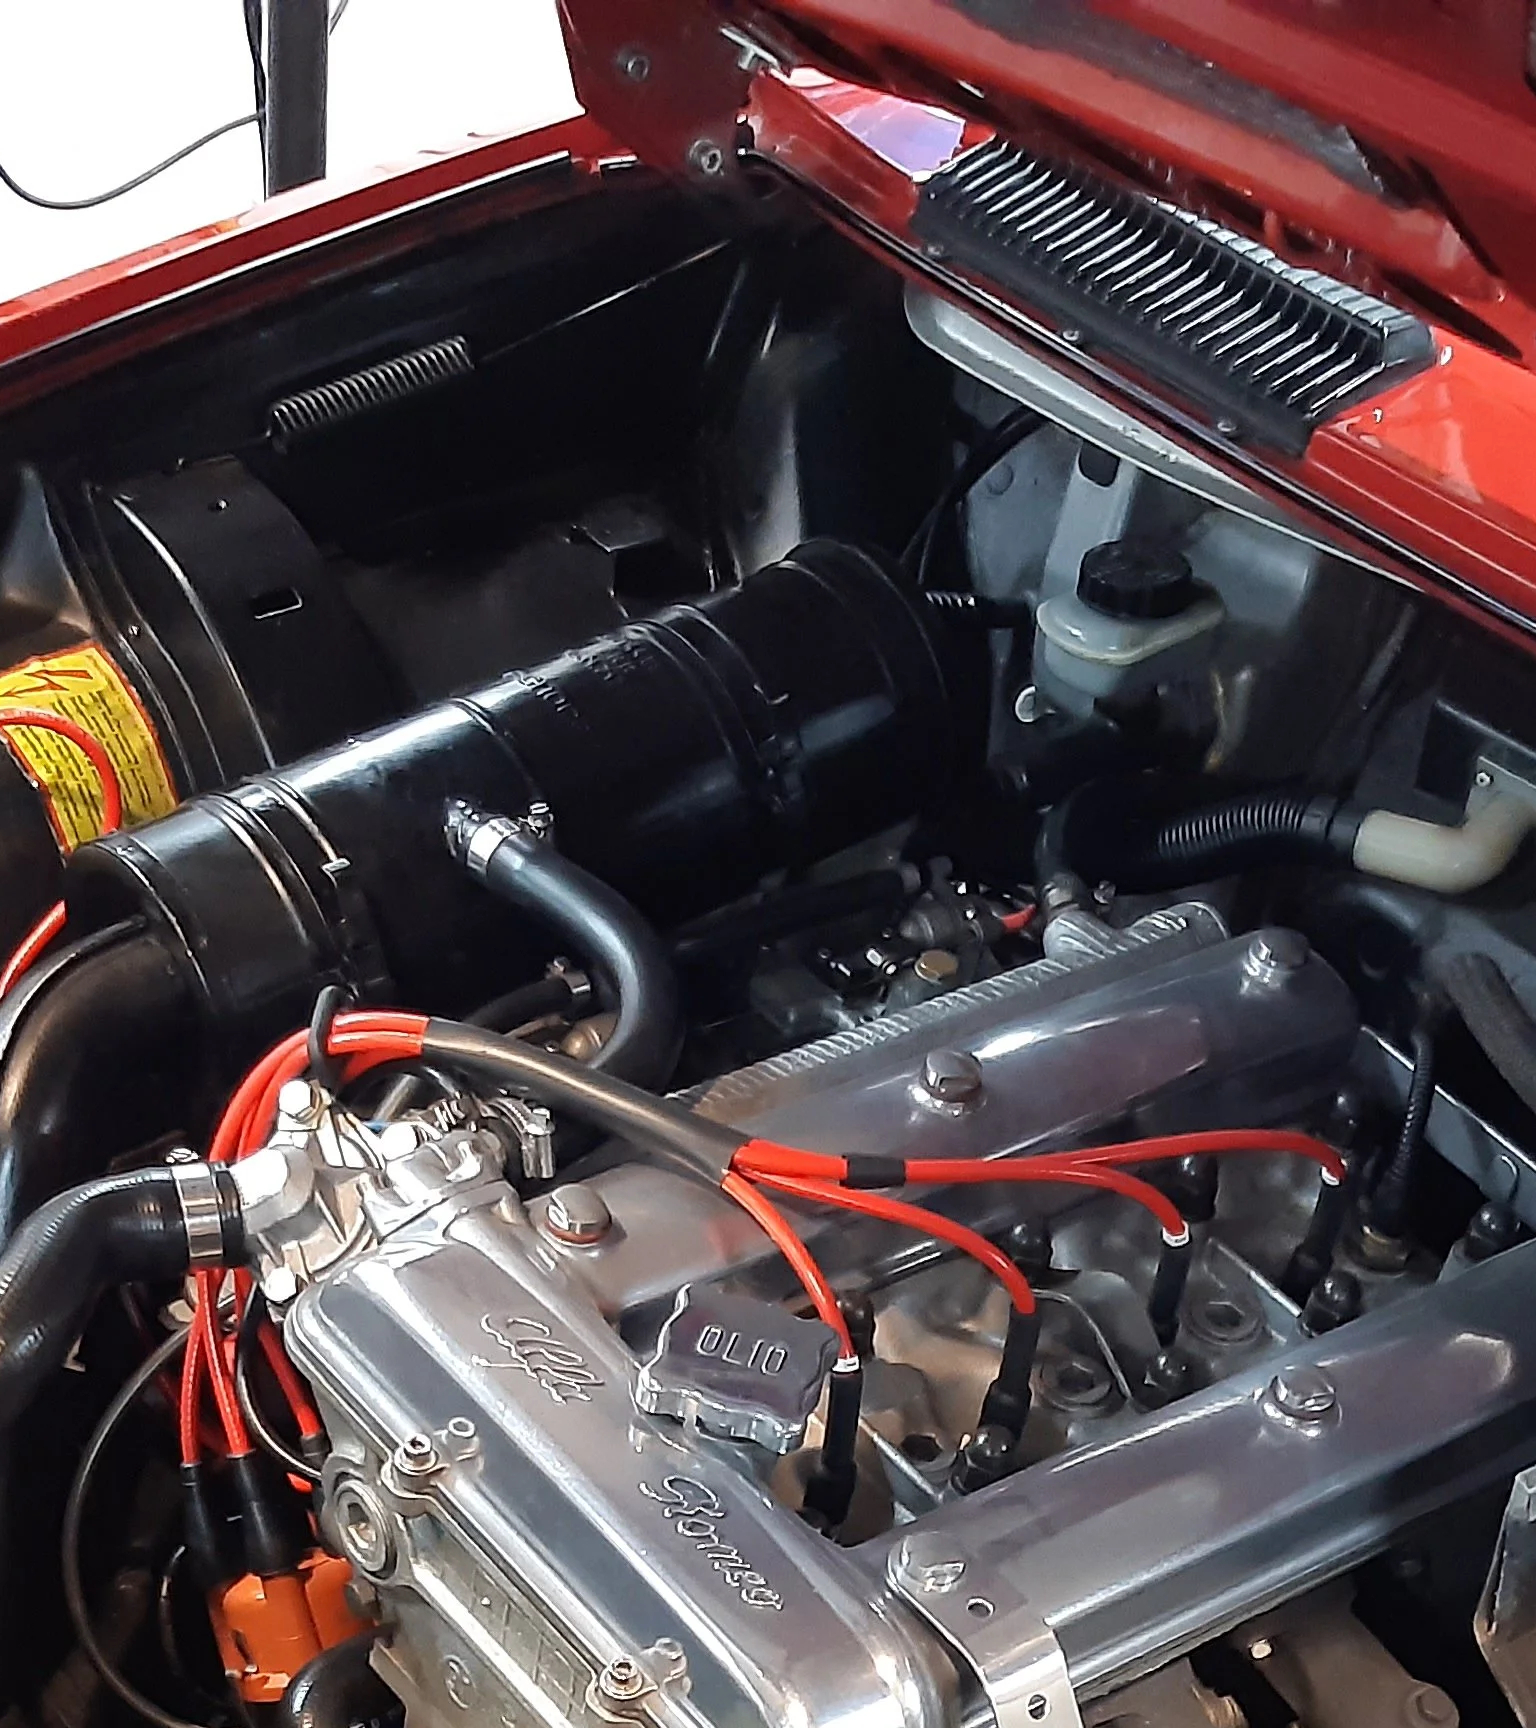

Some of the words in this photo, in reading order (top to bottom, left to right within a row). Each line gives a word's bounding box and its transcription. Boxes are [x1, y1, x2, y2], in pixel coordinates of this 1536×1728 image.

[696, 1324, 788, 1376] OLIO
[470, 1313, 605, 1404] Alfa
[638, 1474, 784, 1611] Romeo
